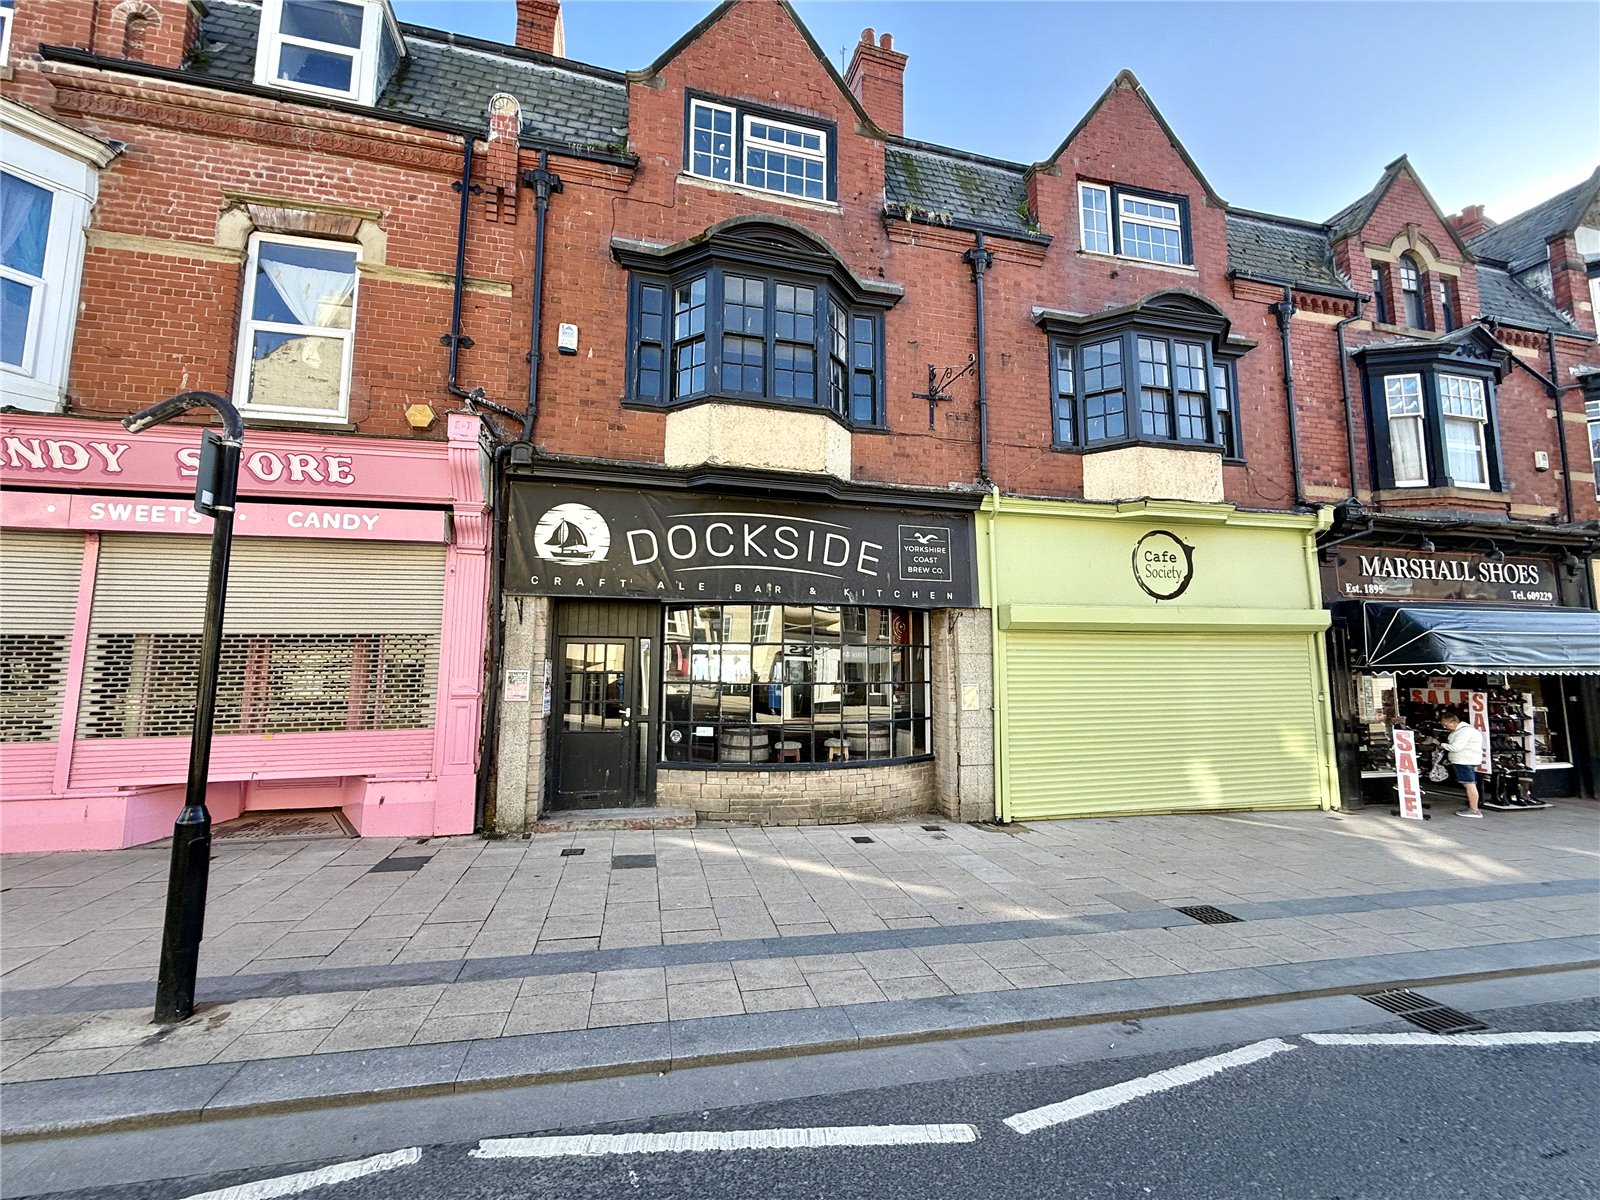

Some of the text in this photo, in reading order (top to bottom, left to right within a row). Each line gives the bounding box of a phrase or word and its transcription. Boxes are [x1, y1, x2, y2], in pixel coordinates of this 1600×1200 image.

[0, 437, 356, 485] NDY SORE
[90, 502, 380, 531] SWEETS CANDY
[626, 522, 883, 577] DOCKSIDE
[903, 545, 946, 554] YORKSHIRE
[1144, 551, 1177, 563] Cafe
[907, 566, 945, 575] BREW CO.
[1145, 564, 1182, 584] Society
[1360, 555, 1540, 585] MARSHALL SHOES
[530, 575, 953, 600] CRAFT ALE BAR & KITCHEN
[1345, 582, 1384, 594] Est. 1895
[1511, 590, 1553, 601] Tel. 609229
[1396, 731, 1418, 818] SALE
